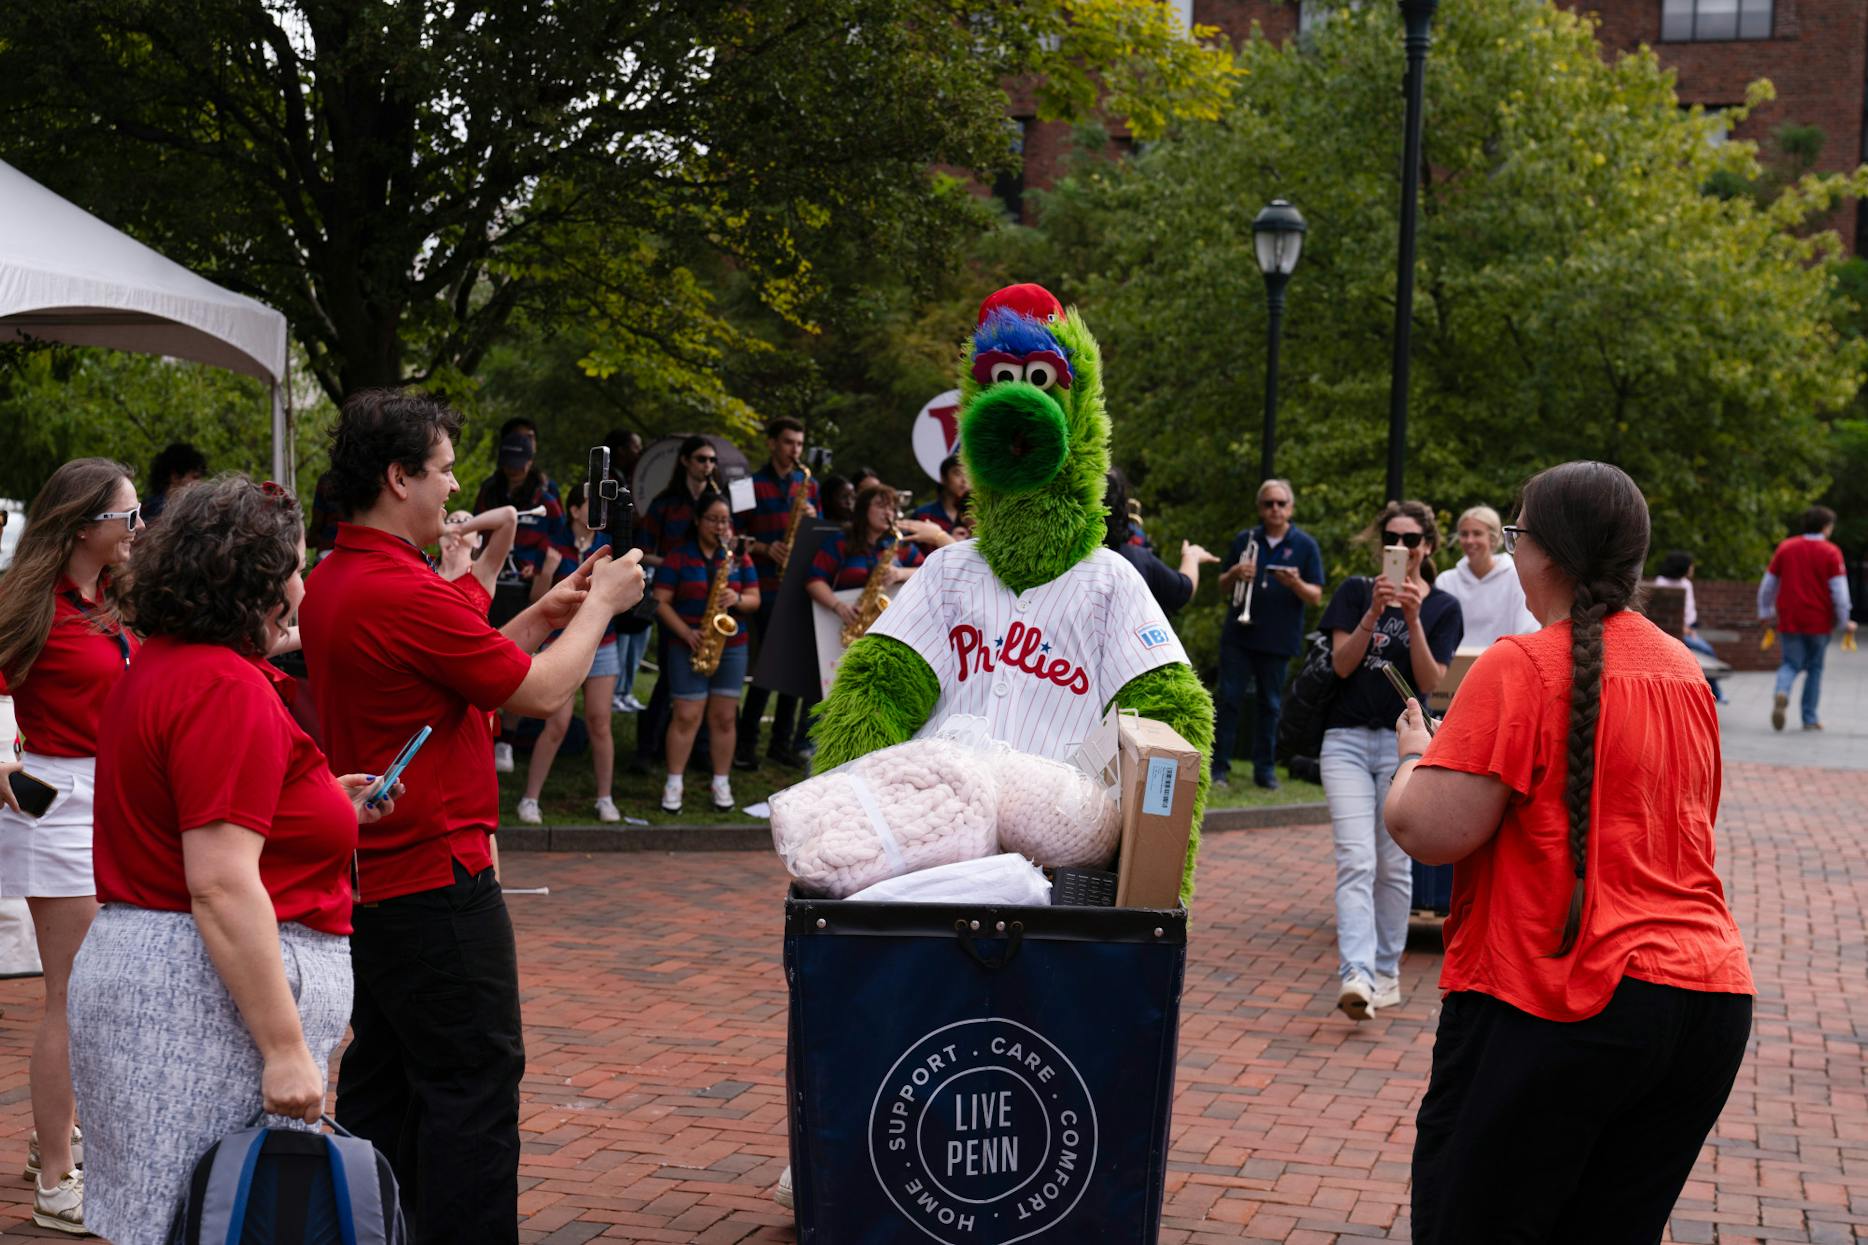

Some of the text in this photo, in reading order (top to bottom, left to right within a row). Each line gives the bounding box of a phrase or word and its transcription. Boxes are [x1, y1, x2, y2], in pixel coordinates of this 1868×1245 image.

[949, 621, 1089, 695] Phillies
[888, 1037, 1080, 1232] SUPPORT CARE COMFORT HOME
[955, 1090, 1012, 1131] LIVE
[947, 1136, 1018, 1177] PENN
